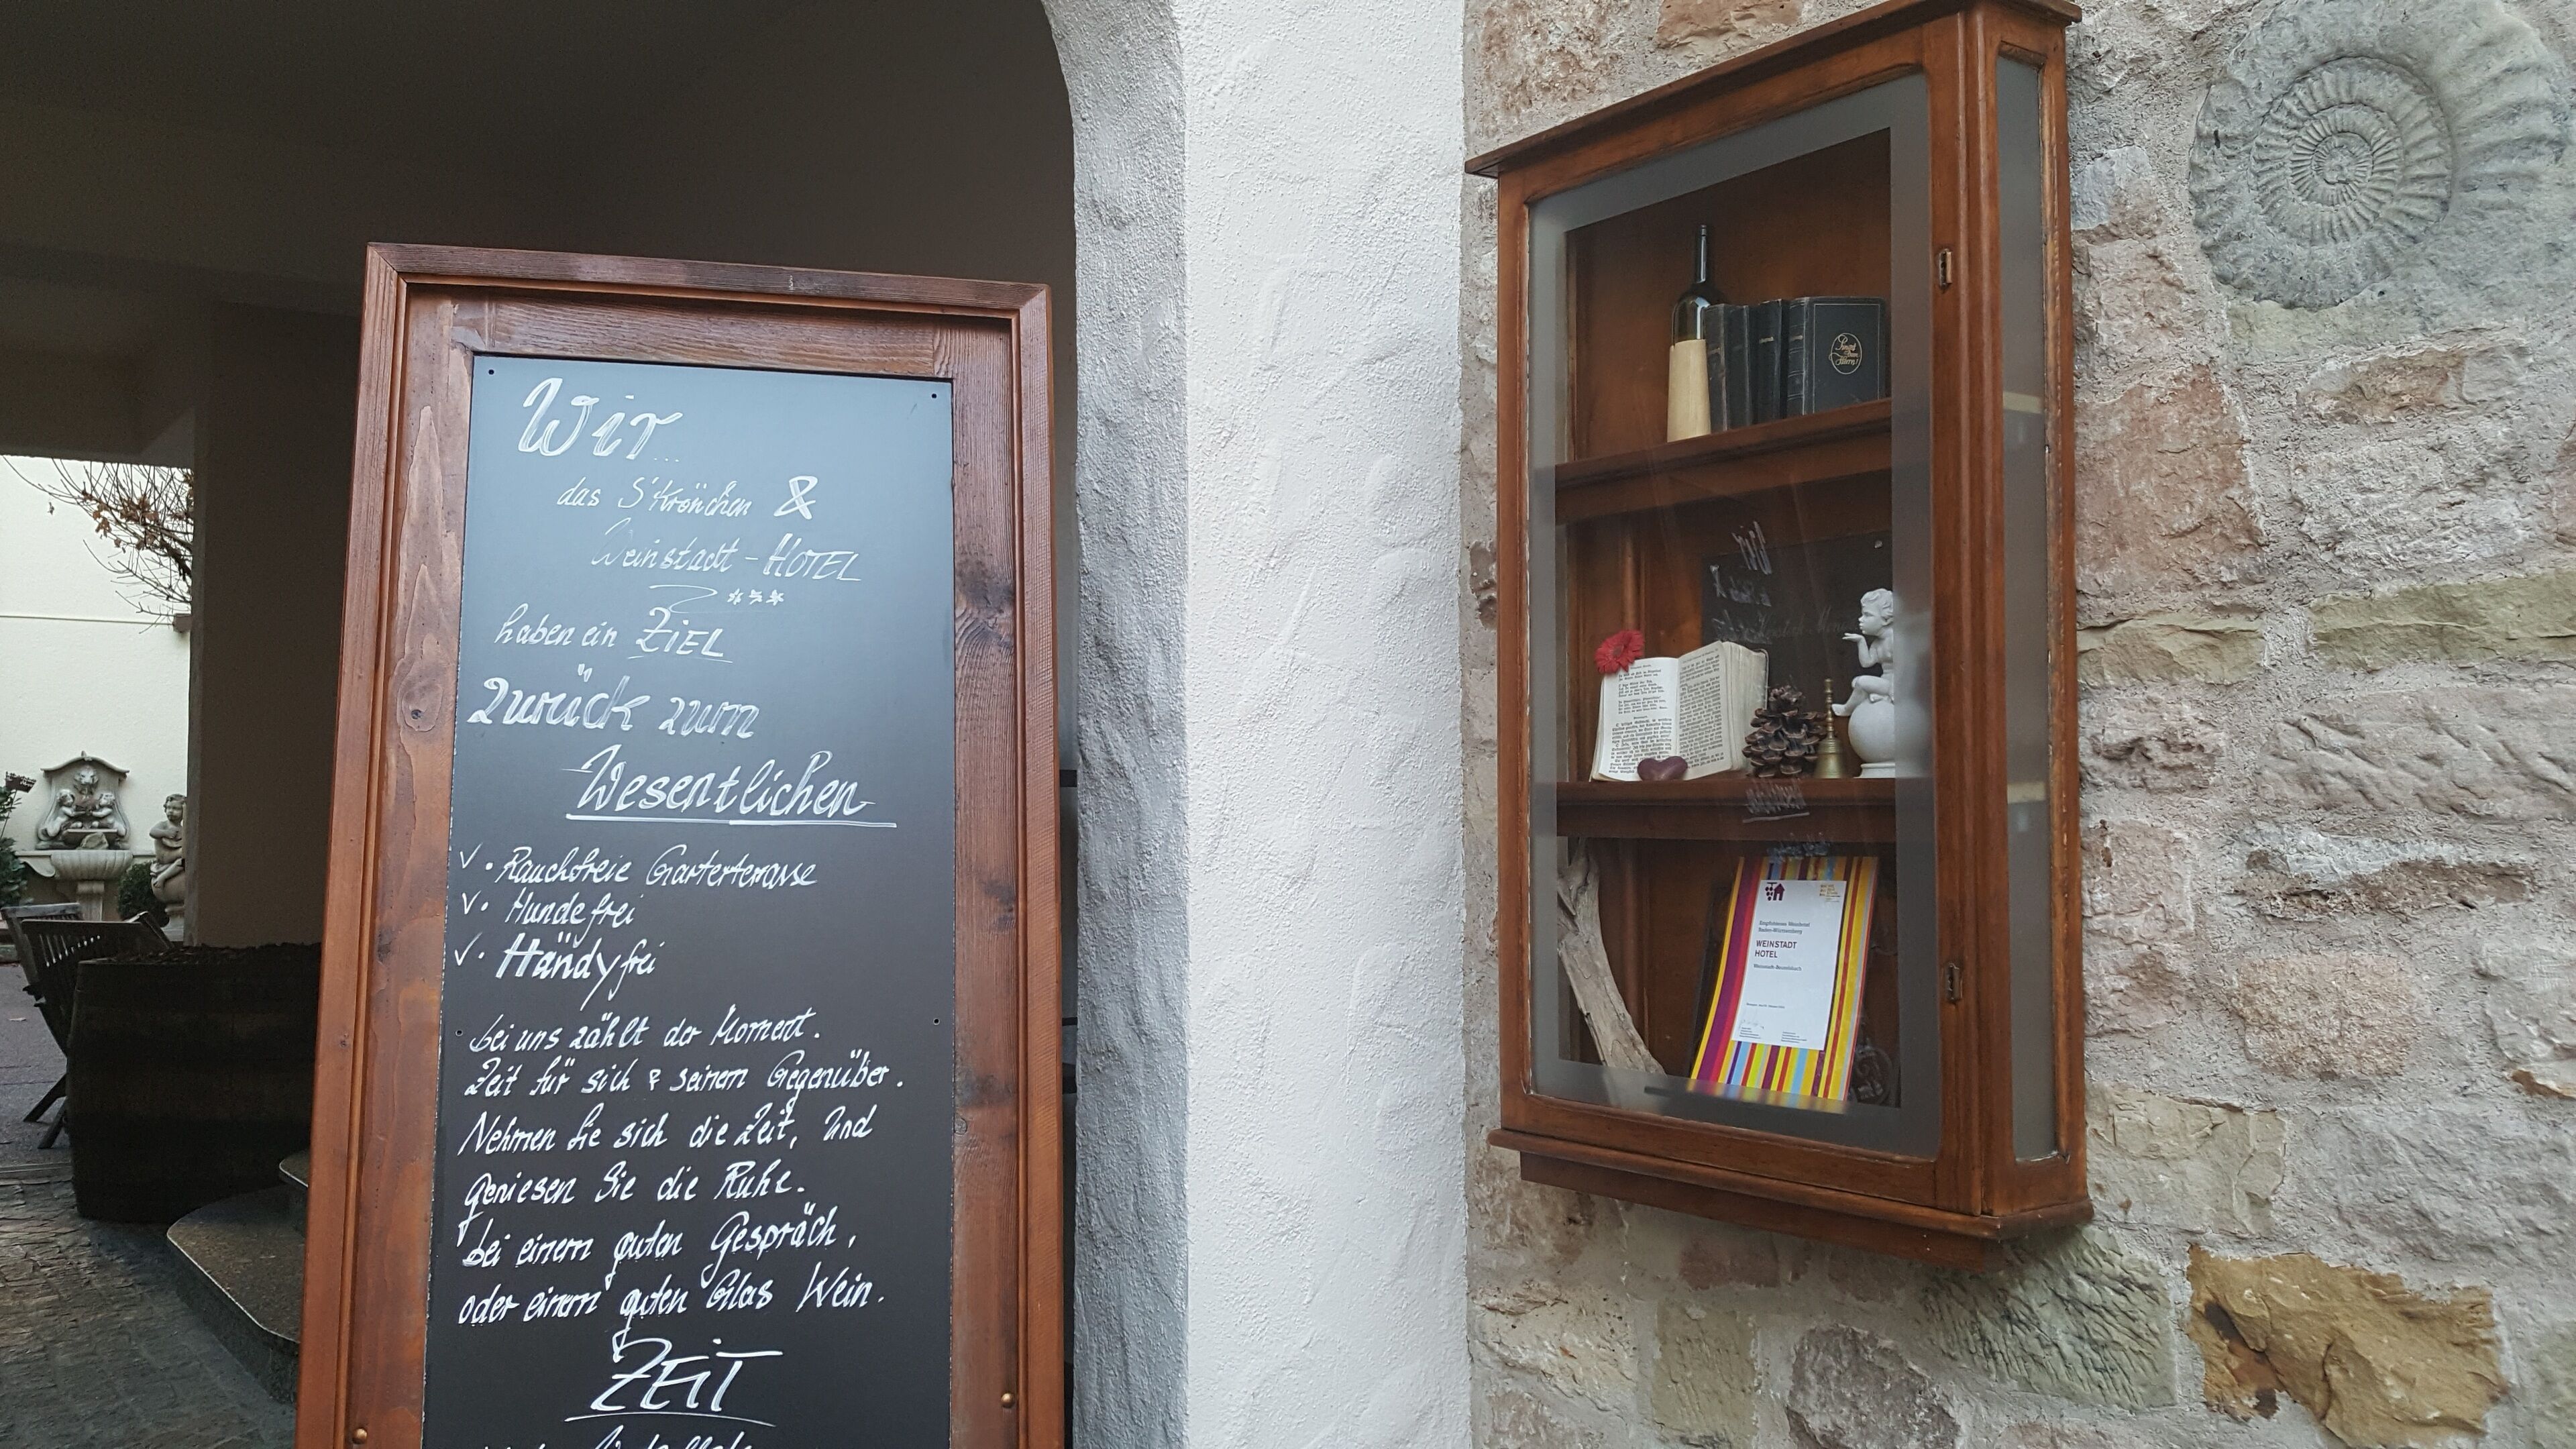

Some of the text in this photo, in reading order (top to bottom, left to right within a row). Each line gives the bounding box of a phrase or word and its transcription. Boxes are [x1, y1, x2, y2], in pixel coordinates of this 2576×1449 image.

[556, 477, 601, 507] das
[763, 533, 862, 581] HOTEL
[494, 603, 576, 645] haben
[581, 621, 619, 648] ein
[658, 696, 760, 739] zum
[562, 744, 875, 817] Wesentlichen
[494, 847, 632, 883] Rauchfreie
[1754, 950, 1778, 958] HOTEL
[1756, 940, 1797, 949] WEINSTADT
[470, 1014, 515, 1052] bei
[515, 1028, 563, 1051] uns
[570, 1012, 650, 1050] zählt
[663, 1018, 702, 1046] der
[464, 1057, 523, 1097] Zeit
[529, 1055, 576, 1095] für
[581, 1058, 639, 1093] sich
[669, 1065, 749, 1092] seinem
[457, 1111, 556, 1155] Nehmen
[567, 1102, 604, 1150] Sie
[613, 1112, 669, 1148] sich
[689, 1115, 729, 1148] die
[594, 1161, 637, 1202] Sie
[657, 1166, 698, 1201] die
[714, 1159, 805, 1199] Ruhe.
[462, 1218, 511, 1267] bei
[515, 1233, 594, 1267] einem
[605, 1220, 683, 1291] guten
[458, 1261, 885, 1350] oder einem guten Glas Wein.
